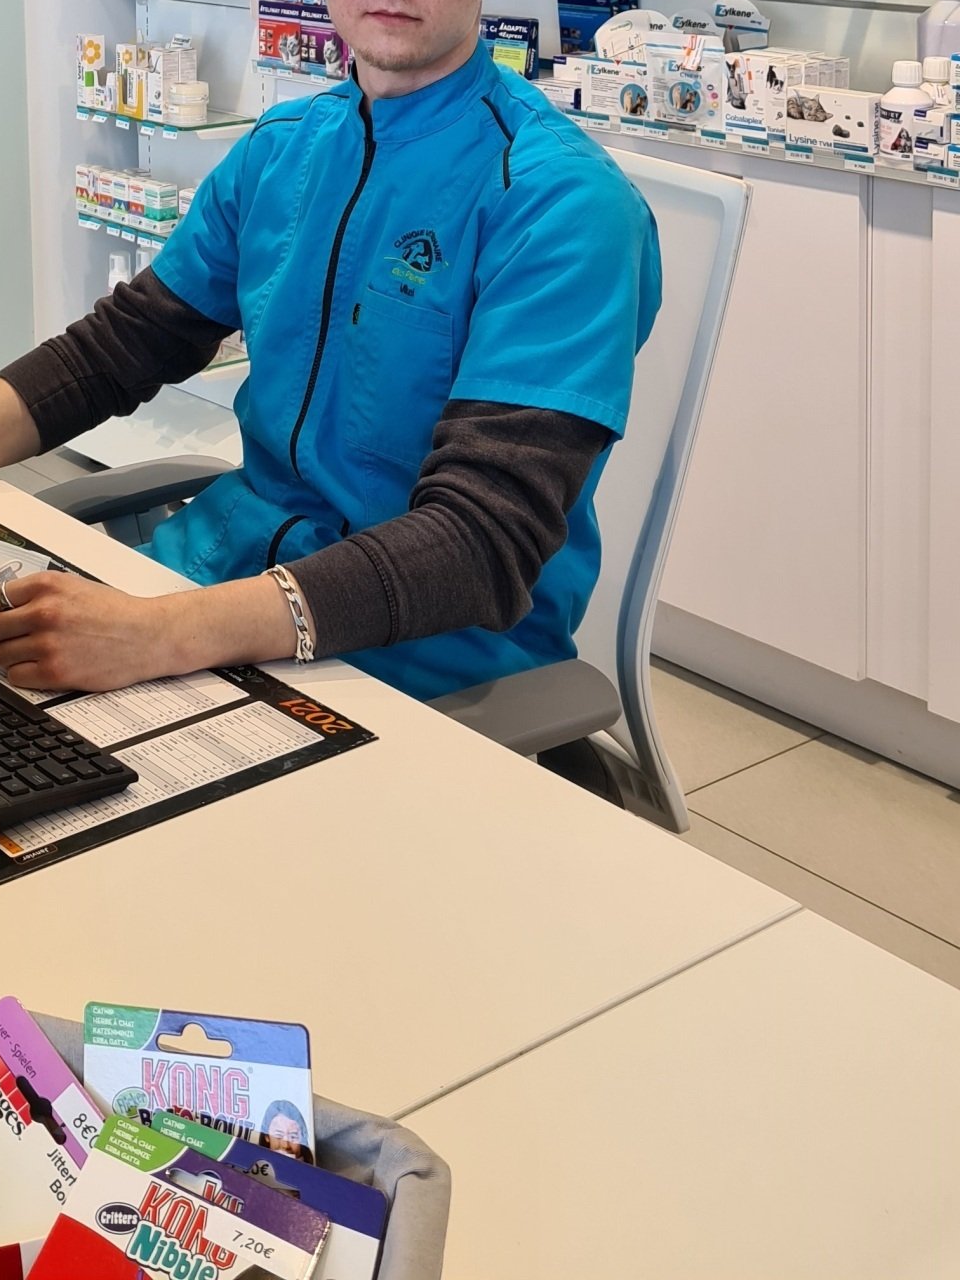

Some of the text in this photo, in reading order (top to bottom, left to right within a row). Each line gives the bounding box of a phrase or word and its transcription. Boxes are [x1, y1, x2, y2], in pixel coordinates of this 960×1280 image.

[715, 4, 752, 19] Zylkene
[503, 23, 528, 34] ADAPTIL
[672, 16, 707, 30] Zylkene
[591, 64, 620, 76] Zylkene
[789, 133, 833, 148] Lysine TVM
[279, 698, 354, 734] 2021
[22, 847, 50, 861] Janvier
[93, 1006, 114, 1015] CATNIP
[92, 1017, 113, 1026] HERBE
[118, 1019, 135, 1028] CHAT
[11, 1043, 37, 1079] Spielen
[141, 1057, 250, 1120] KONG
[117, 1119, 140, 1134] CATNIP
[162, 1117, 186, 1130] CATNIP
[113, 1127, 134, 1143] HERBE
[138, 1140, 157, 1152] CHAT
[160, 1127, 181, 1142] HERBE
[186, 1136, 205, 1148] CHAT
[105, 1144, 141, 1167] ERBA GATTA
[108, 1136, 152, 1161] KATZENMINZE
[100, 1210, 138, 1226] Critters
[233, 1230, 276, 1260] 7,20€
